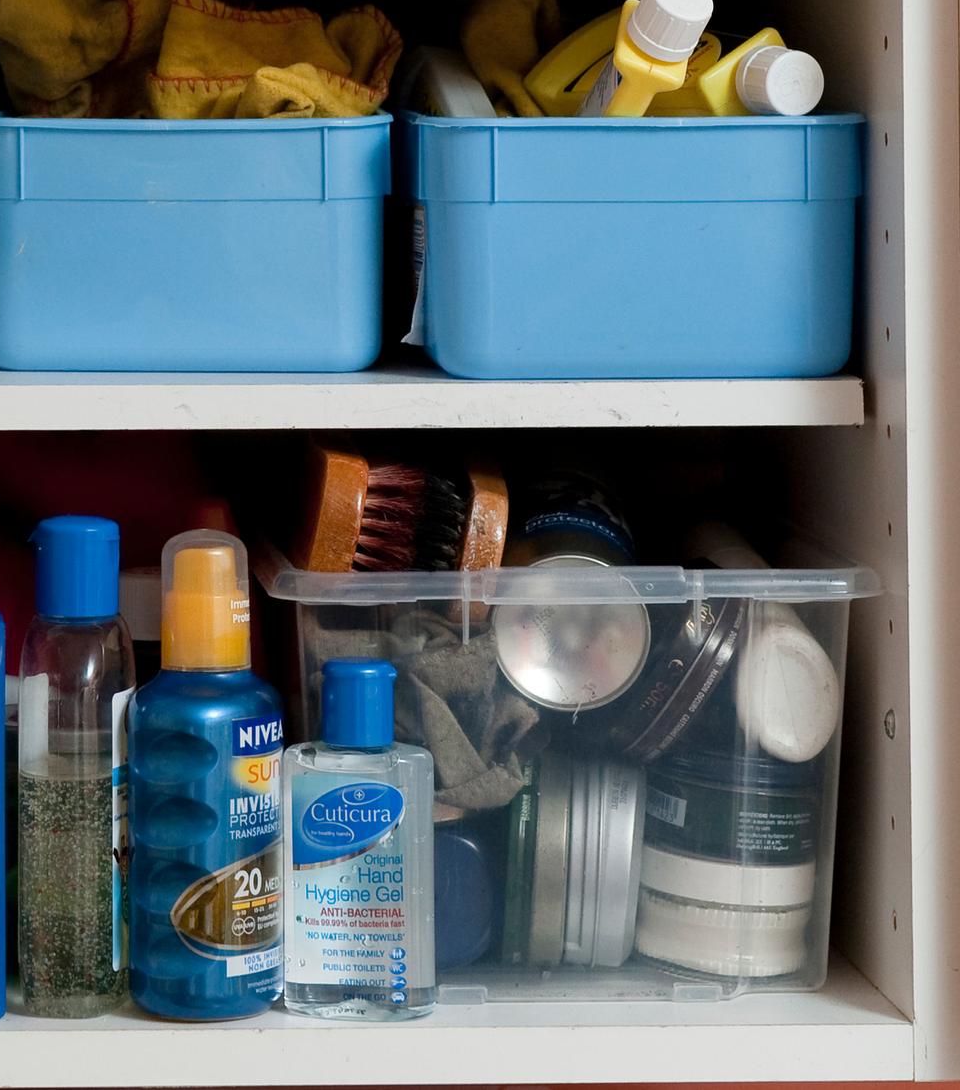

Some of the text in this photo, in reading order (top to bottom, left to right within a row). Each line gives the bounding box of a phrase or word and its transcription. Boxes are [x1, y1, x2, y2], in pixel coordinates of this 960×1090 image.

[239, 718, 283, 750] NIVEA
[310, 803, 392, 824] Cuticura
[363, 853, 404, 869] Original
[357, 867, 404, 884] Hand
[234, 867, 263, 899] 20
[305, 883, 404, 906] Hygiene Gel
[319, 908, 405, 919] ANTI-BACTERIAL
[304, 917, 406, 928] Kills 99.99% of bacteria fast
[352, 932, 367, 941] NO
[322, 949, 386, 958] FOR THE FAMILY
[322, 963, 405, 973] PUBLIC TOILETS WC
[338, 978, 386, 988] EATING OUT
[356, 993, 374, 1001] THE
[374, 993, 386, 1002] GO
